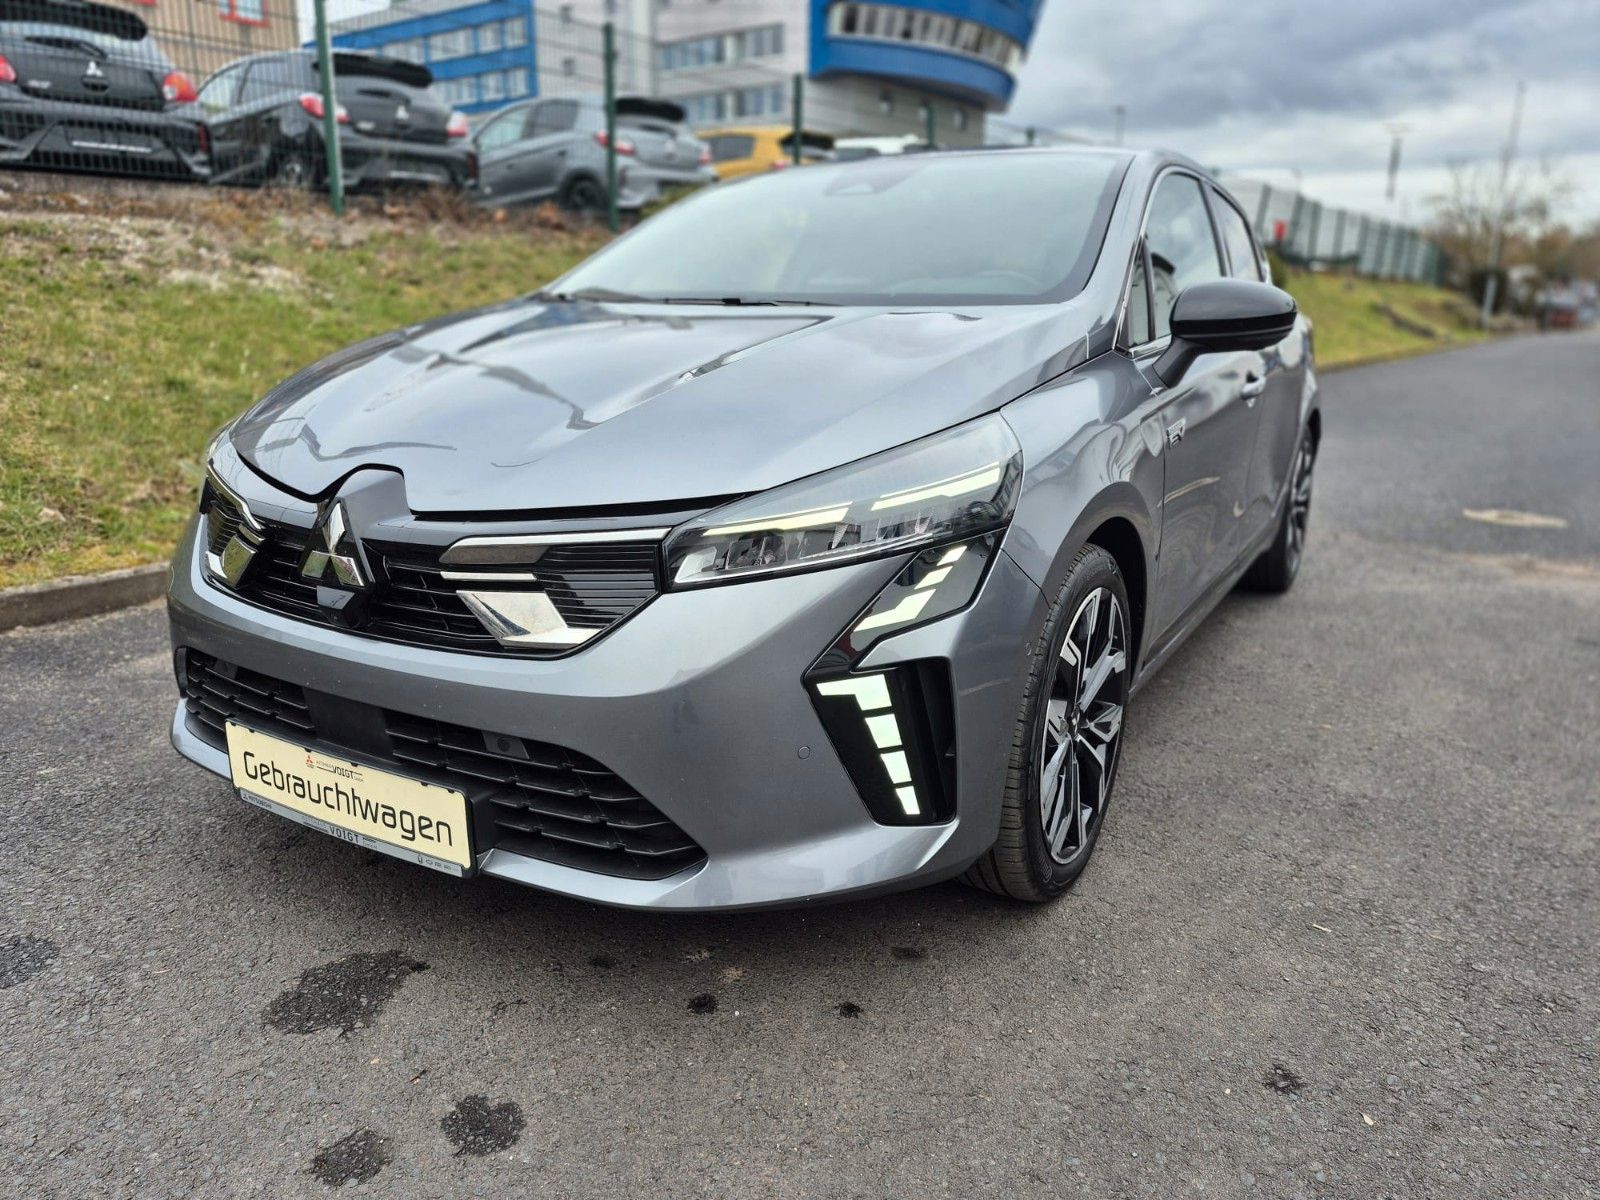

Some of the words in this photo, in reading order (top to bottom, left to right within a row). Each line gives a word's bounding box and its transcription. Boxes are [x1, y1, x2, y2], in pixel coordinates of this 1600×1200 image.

[332, 765, 354, 780] VOIGT
[243, 750, 453, 847] Gebrauchtwagen
[329, 825, 359, 844] VOIGT
